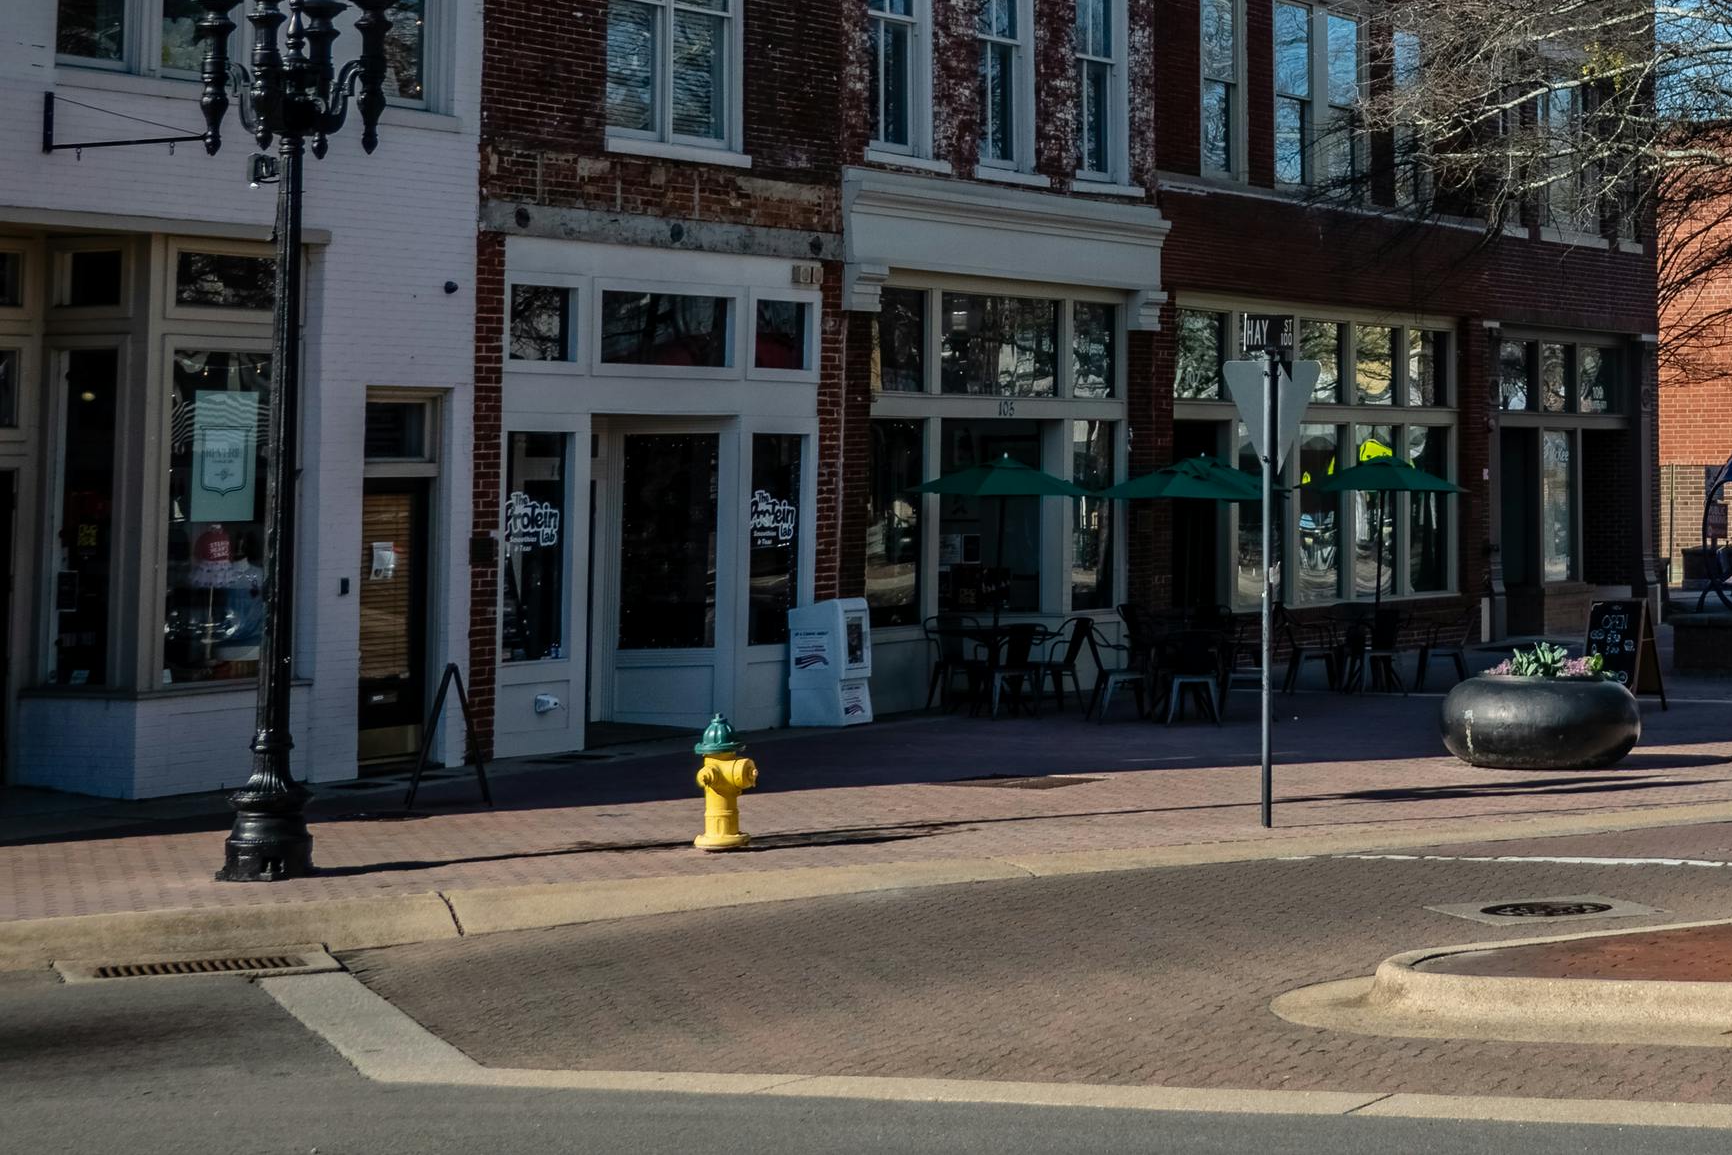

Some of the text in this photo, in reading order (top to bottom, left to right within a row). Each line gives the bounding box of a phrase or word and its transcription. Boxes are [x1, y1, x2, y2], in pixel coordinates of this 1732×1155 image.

[1247, 319, 1293, 346] HAY ST
[1281, 333, 1293, 346] 100
[511, 492, 529, 506] The
[755, 490, 770, 504] The
